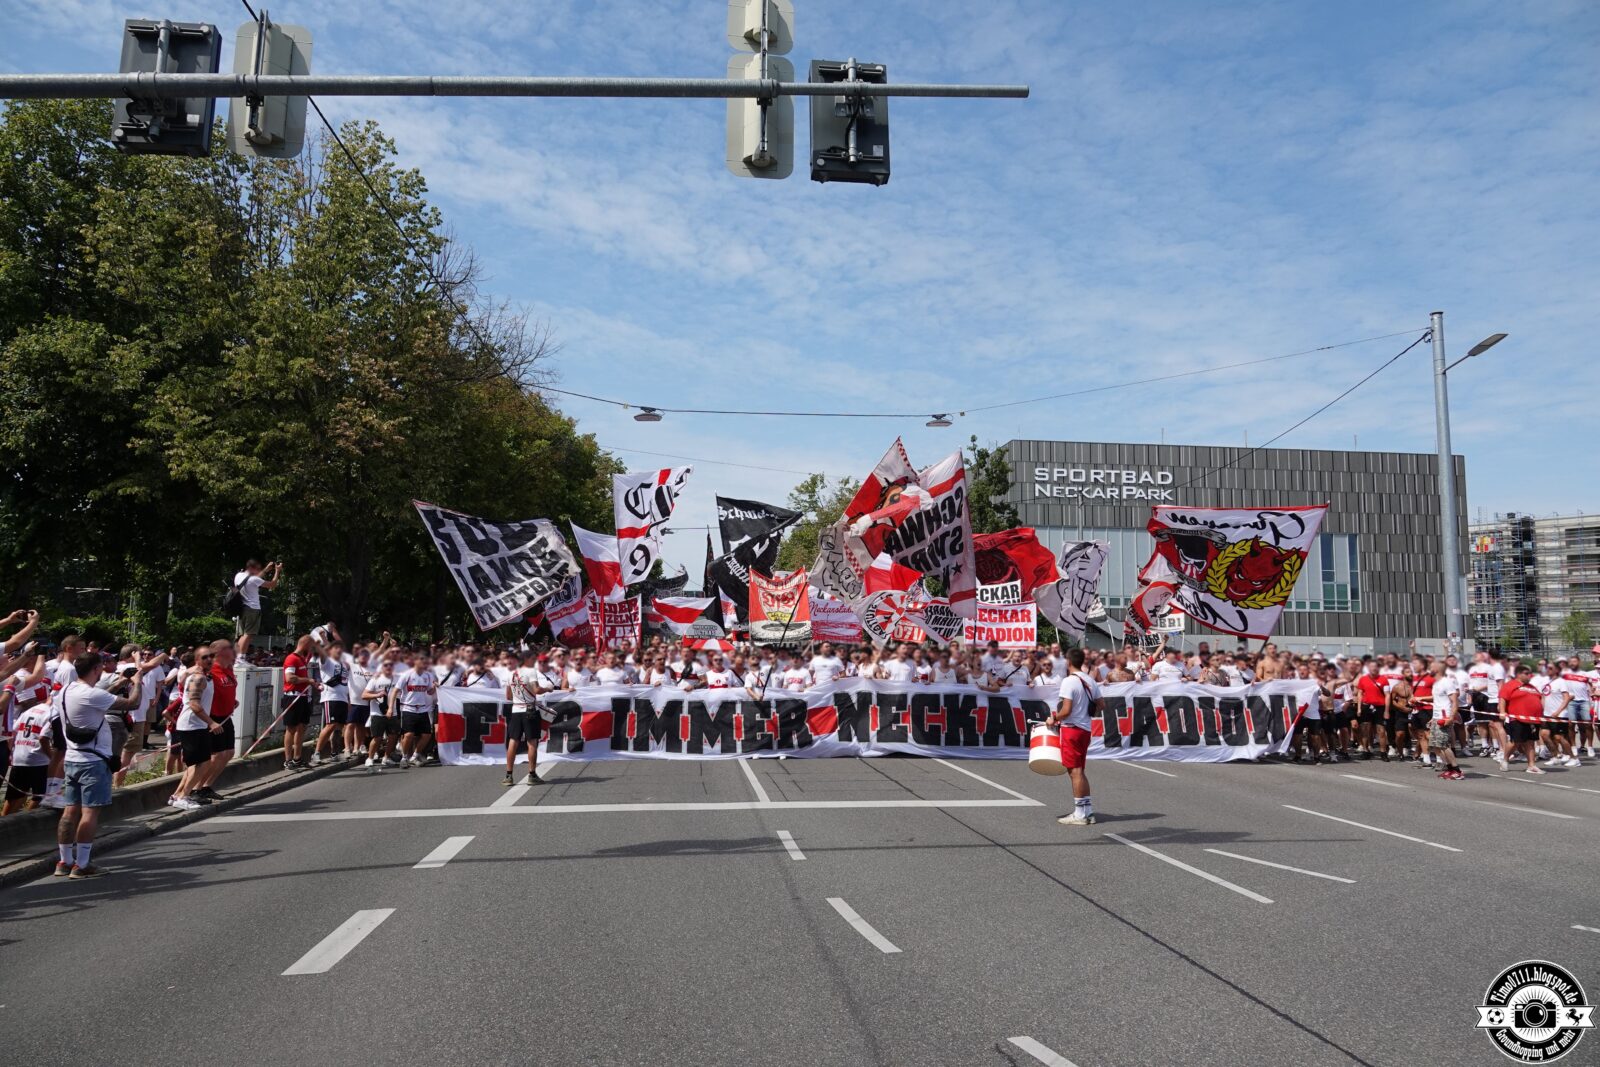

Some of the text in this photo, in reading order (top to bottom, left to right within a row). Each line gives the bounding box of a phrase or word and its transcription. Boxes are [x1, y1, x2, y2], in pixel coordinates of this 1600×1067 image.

[1034, 467, 1173, 485] SPORTBAD
[977, 583, 1020, 602] CKAR
[590, 611, 640, 624] EIZELNE
[977, 608, 1032, 623] ECKAR
[964, 625, 1035, 642] STADION
[23, 716, 35, 738] 5
[461, 690, 1298, 755] FR IMMER NECKARTADION
